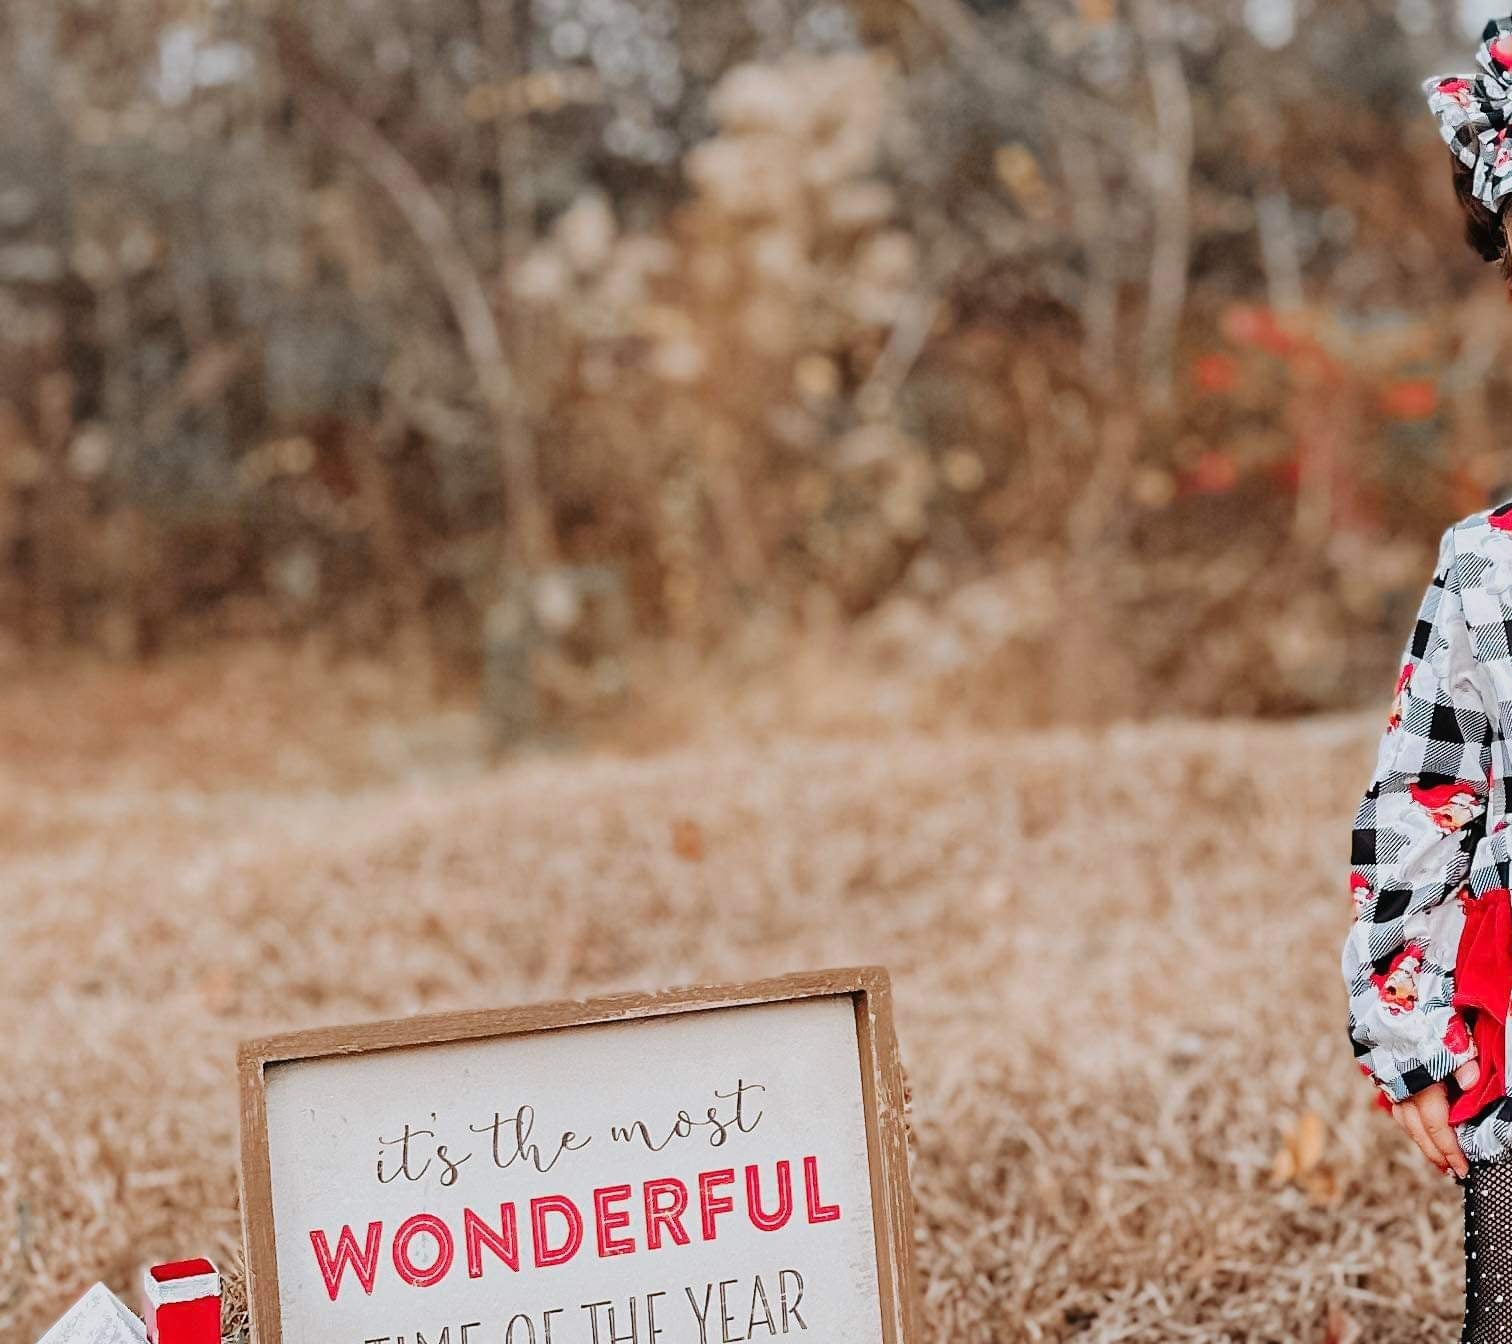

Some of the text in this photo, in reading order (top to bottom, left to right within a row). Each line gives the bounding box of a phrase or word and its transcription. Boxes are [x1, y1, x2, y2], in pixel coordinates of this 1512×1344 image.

[376, 1078, 766, 1187] it's the most
[308, 1155, 841, 1302] WONDERFUL
